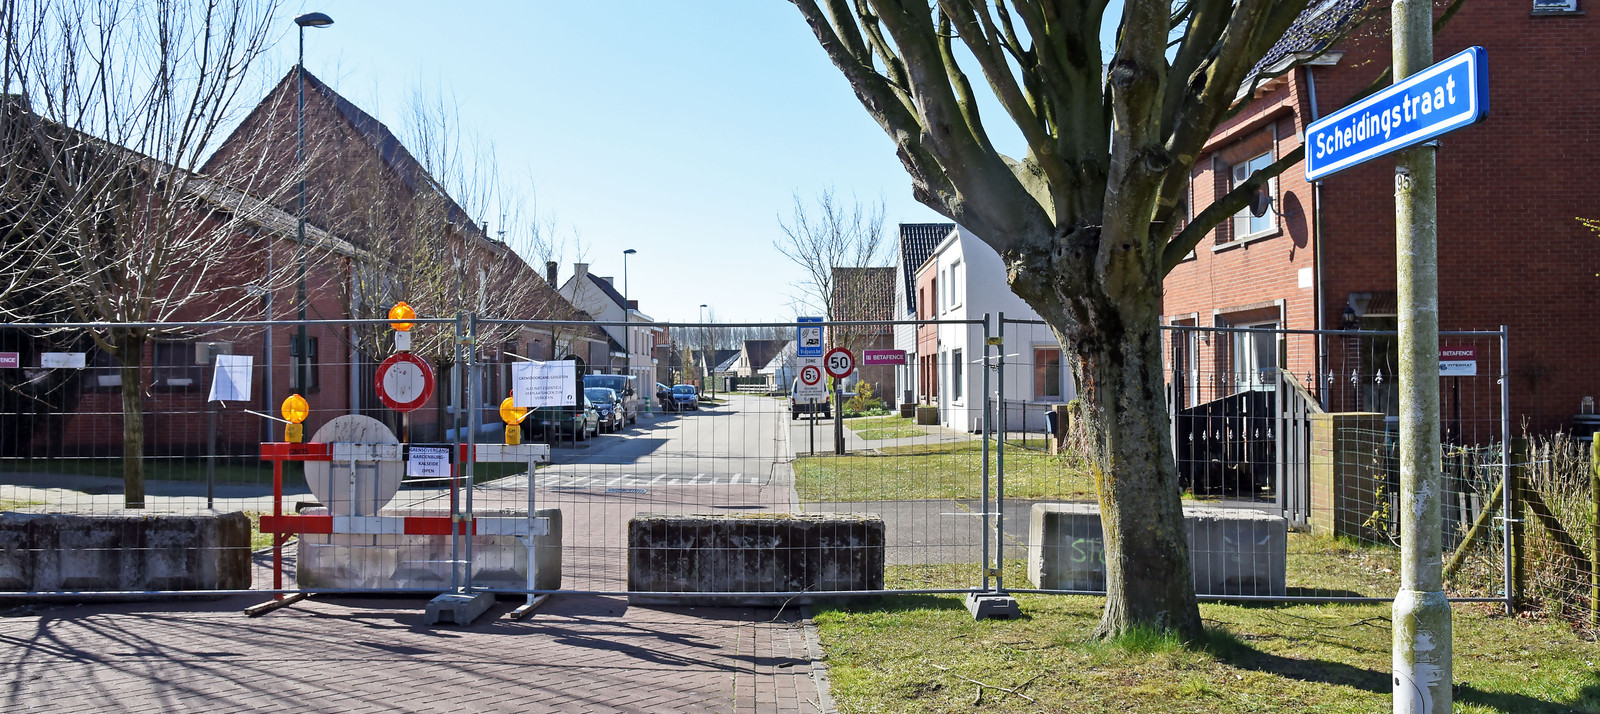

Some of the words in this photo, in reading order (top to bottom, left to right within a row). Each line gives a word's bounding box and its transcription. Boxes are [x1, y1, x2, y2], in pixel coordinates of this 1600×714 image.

[1316, 74, 1456, 159] Scheidingstraat
[1398, 175, 1411, 192] 95
[830, 356, 848, 369] 50
